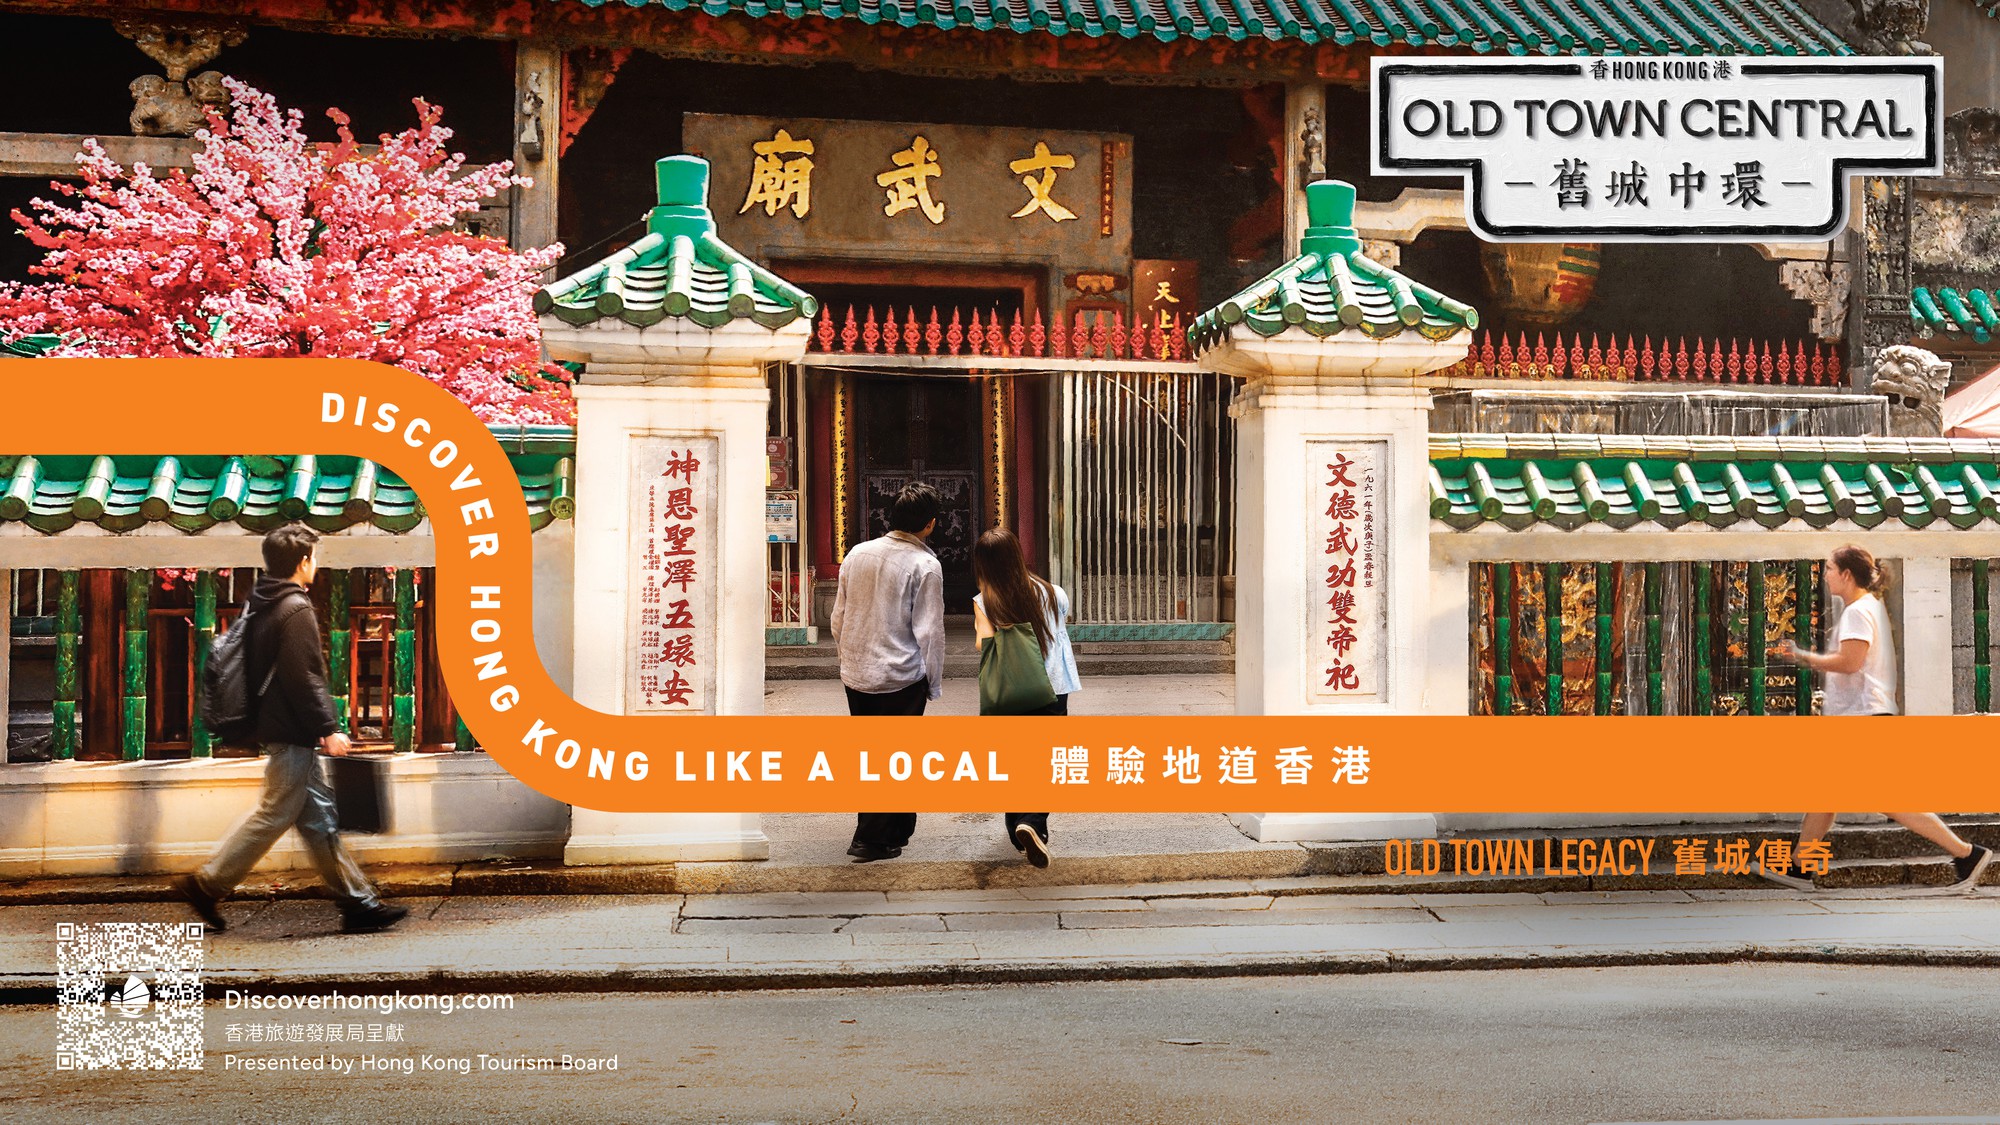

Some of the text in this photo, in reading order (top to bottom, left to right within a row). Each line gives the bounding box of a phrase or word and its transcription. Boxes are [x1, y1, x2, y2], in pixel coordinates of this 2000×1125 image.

[1325, 453, 1360, 691] 文德武功雙帝祀
